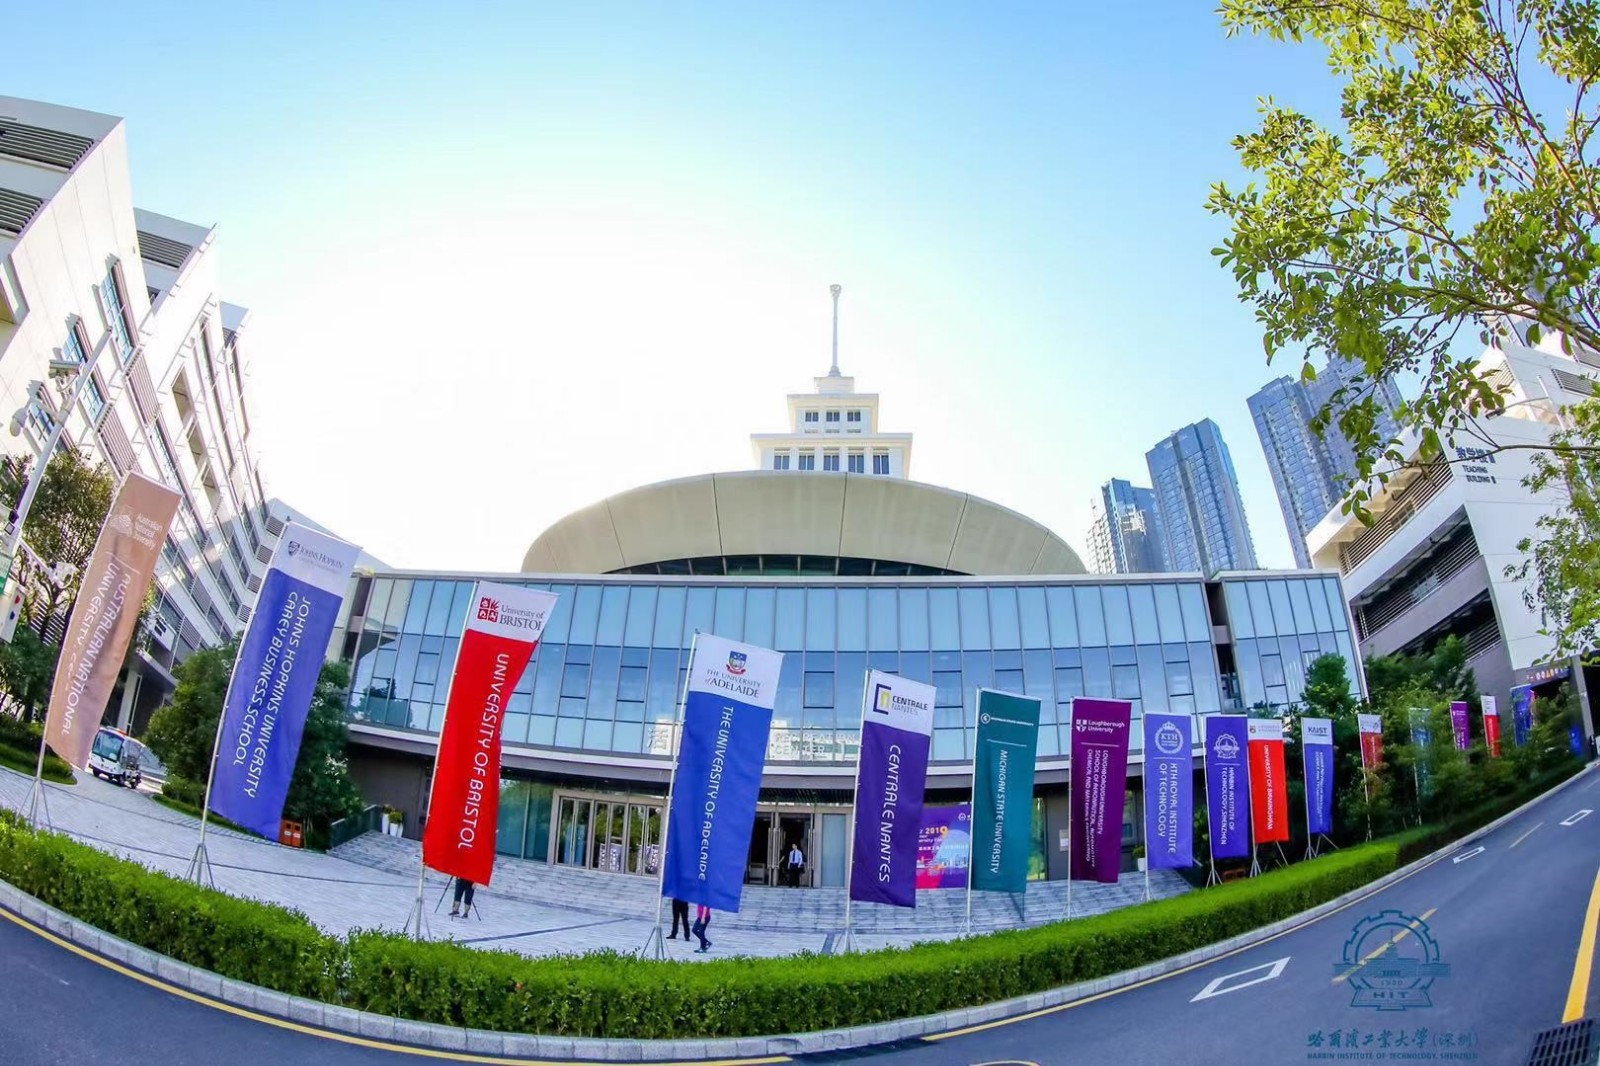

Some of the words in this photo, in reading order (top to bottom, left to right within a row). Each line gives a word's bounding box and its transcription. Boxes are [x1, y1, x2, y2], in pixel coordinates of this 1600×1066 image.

[76, 562, 120, 645] UNIVERSITY
[86, 574, 131, 657] AUSTRALIAN
[276, 592, 298, 637] CAREY
[288, 596, 311, 647] JOHNS
[501, 605, 535, 618] University
[536, 611, 545, 619] of
[252, 636, 283, 705] BUSINESS
[267, 649, 296, 714] HOPKINS
[710, 678, 760, 698] ADELAIDE
[721, 672, 761, 688] UNIVERSITY
[62, 657, 93, 735] NATIONAL
[478, 653, 510, 748] UNIVERSITY
[720, 706, 734, 728] THE
[892, 695, 929, 711] CENTRALE
[233, 706, 259, 765] SCHOOL
[1087, 725, 1113, 734] University
[1088, 720, 1125, 729] Loughborough
[1308, 726, 1328, 734] KAIST
[244, 714, 276, 798] UNIVERSITY
[473, 751, 489, 776] OF
[705, 728, 730, 799] UNIVERSITY
[998, 749, 1008, 792] MICHIGAN
[1093, 750, 1101, 773] SCHOOL
[1100, 750, 1108, 801] LOUGHBOROUGH
[1160, 763, 1167, 777] OF
[882, 744, 901, 819] CENTRALE
[1169, 780, 1177, 809] ROYAL
[458, 778, 484, 848] BRISTOL
[704, 800, 716, 819] OF
[995, 793, 1006, 821] STATE
[1097, 801, 1105, 834] UNIVERSITY
[1158, 778, 1167, 837] TECHNOLOGY
[1228, 821, 1235, 830] OF
[698, 820, 712, 881] ADELAIDE
[879, 821, 893, 882] NANTES
[990, 821, 1003, 873] UNIVERSITY
[1168, 810, 1177, 853] INSTITUTE
